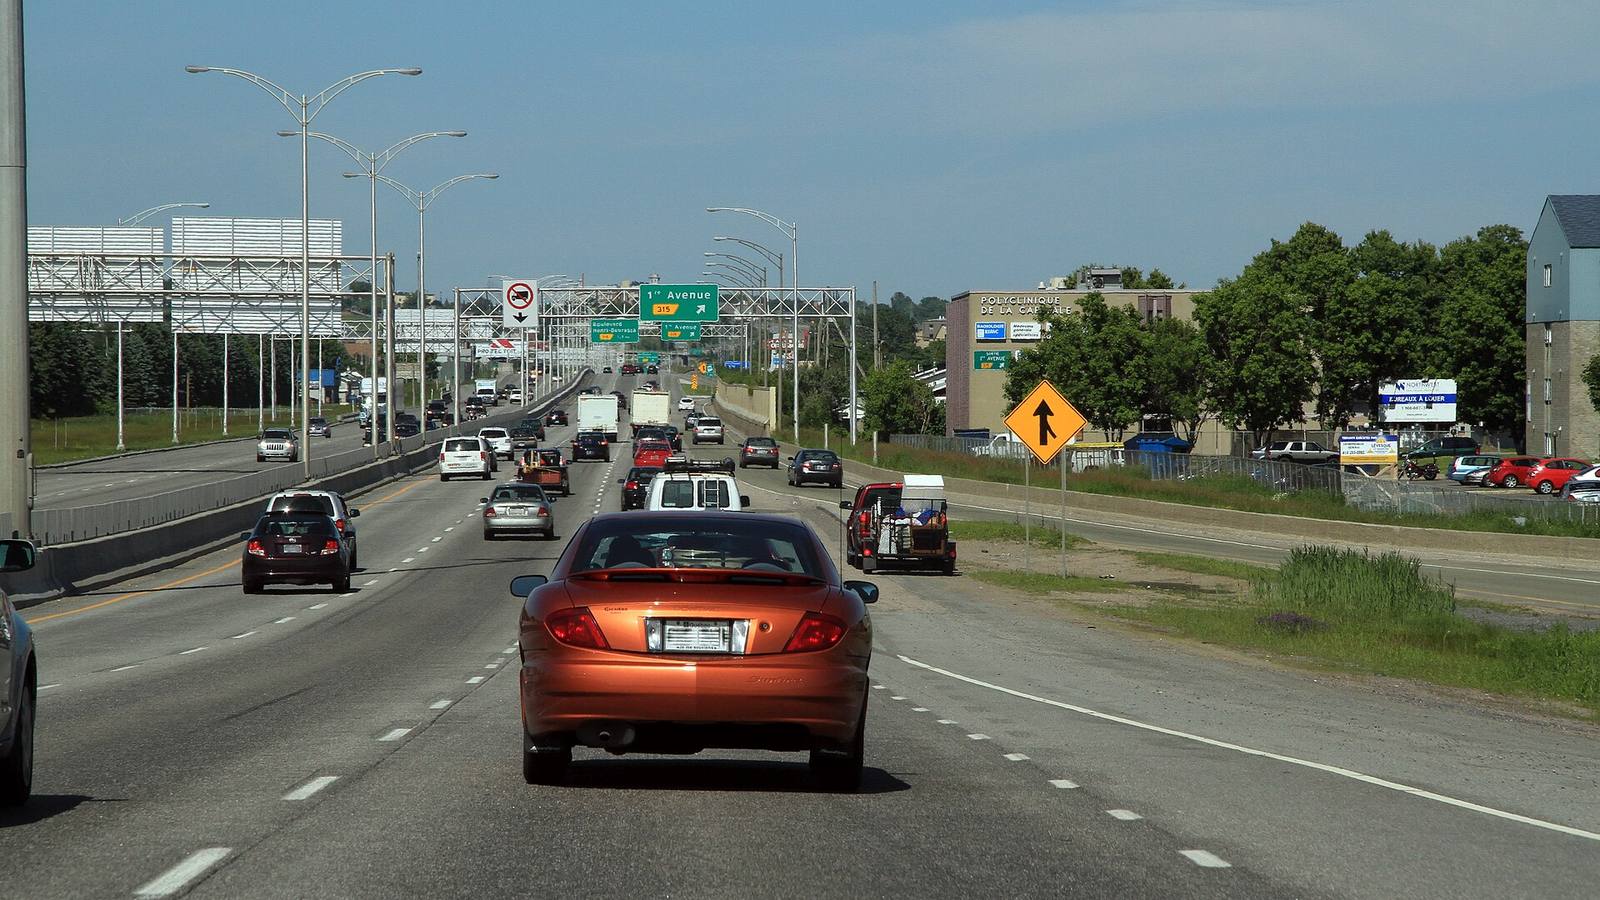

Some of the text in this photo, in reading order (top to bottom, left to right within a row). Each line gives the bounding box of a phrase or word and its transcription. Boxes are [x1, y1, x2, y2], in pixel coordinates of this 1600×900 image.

[667, 291, 711, 300] Avenue
[980, 296, 1060, 305] POLYCLINIQUE
[981, 306, 994, 315] DE
[1000, 306, 1013, 315] LA
